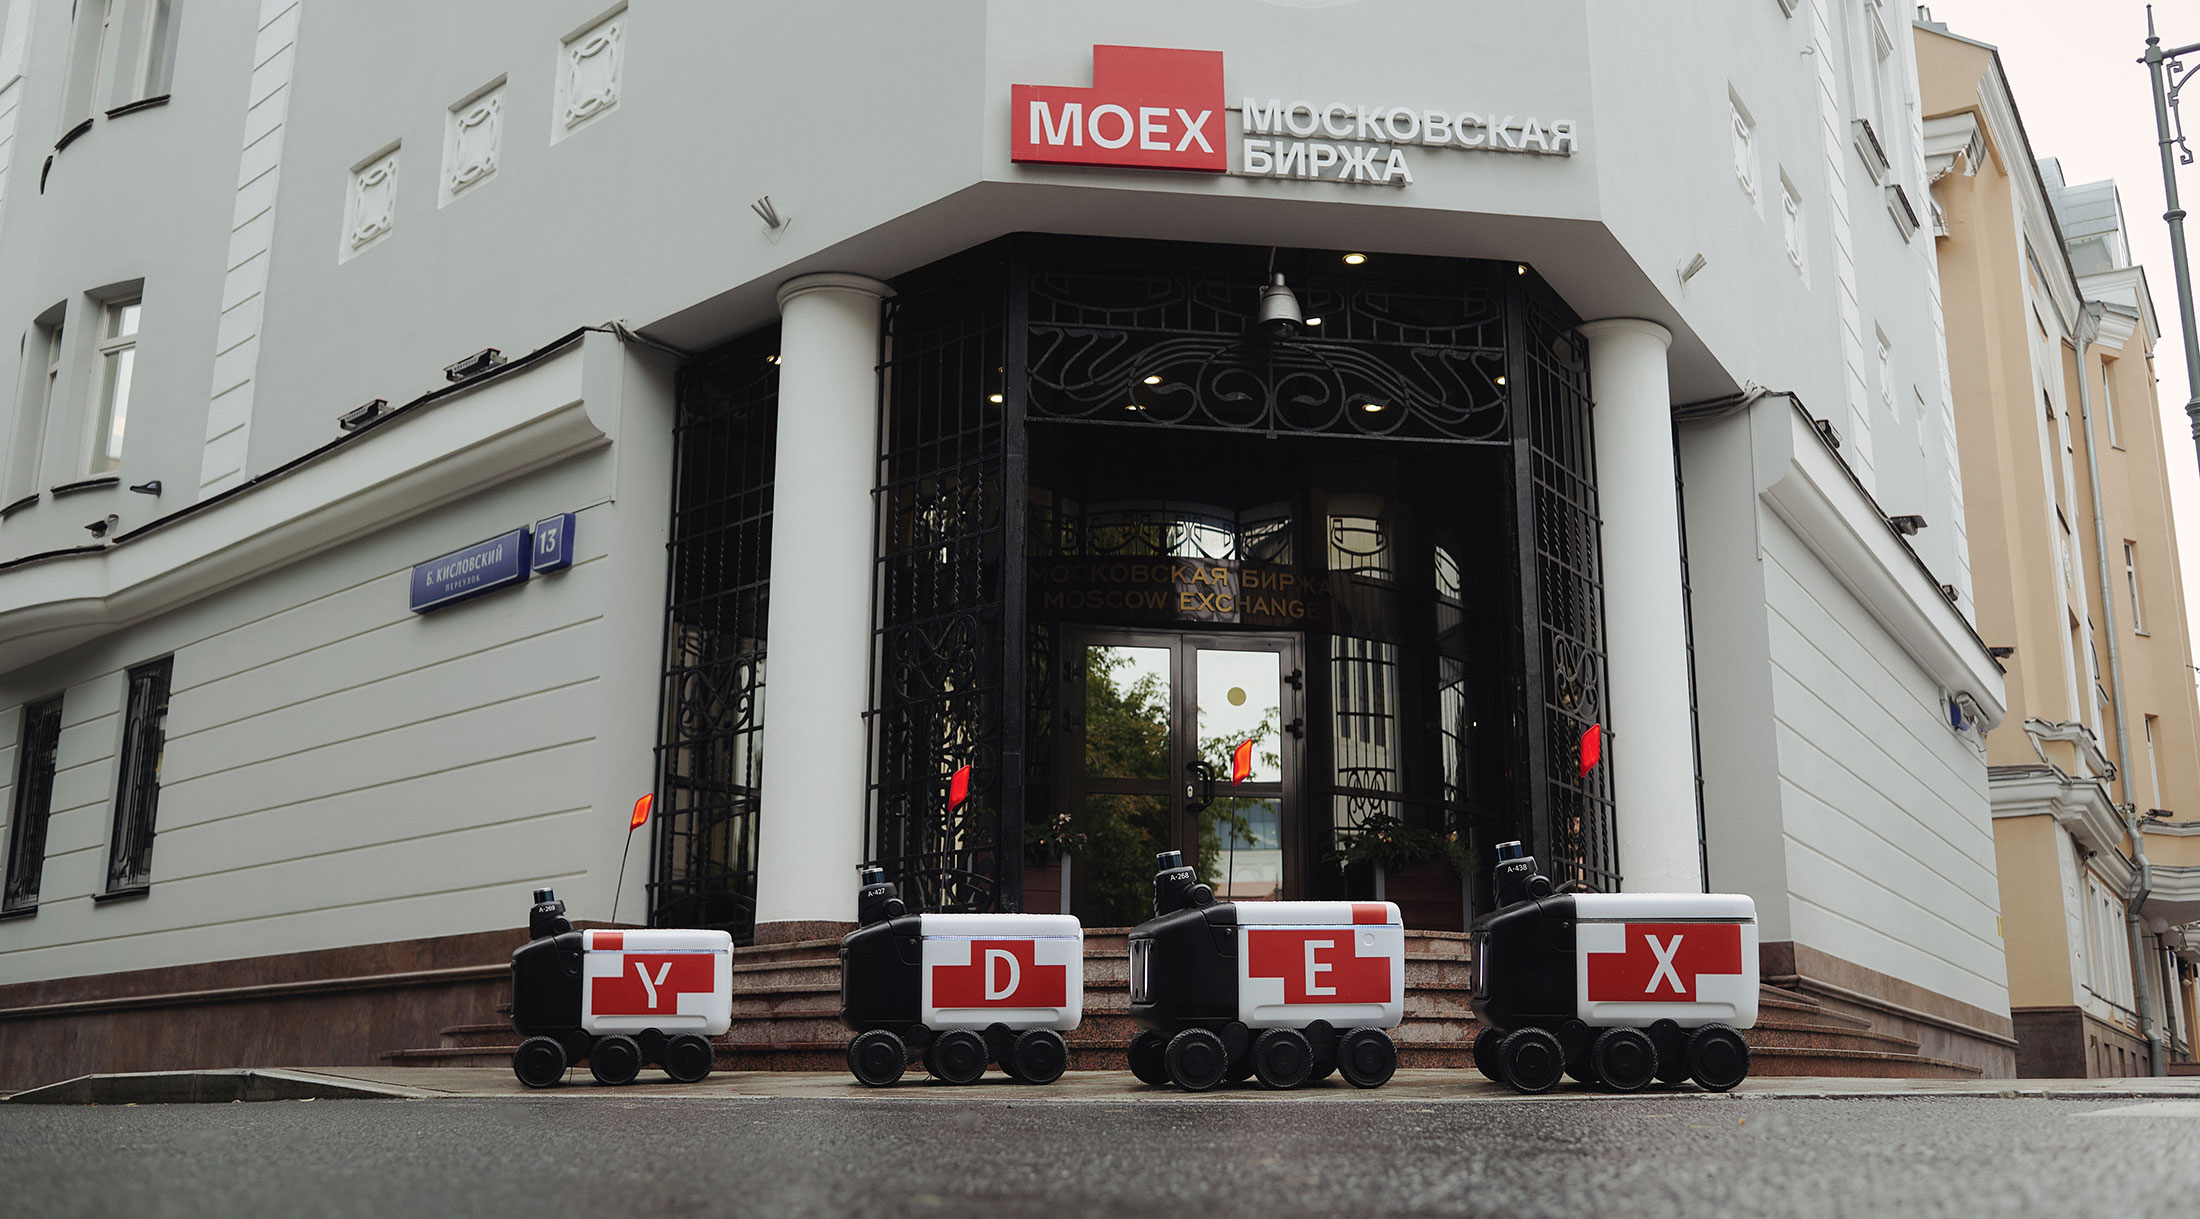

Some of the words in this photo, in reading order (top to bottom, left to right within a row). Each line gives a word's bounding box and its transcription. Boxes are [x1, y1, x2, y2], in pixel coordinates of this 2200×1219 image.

[1029, 101, 1215, 153] MOEX
[1242, 97, 1577, 154] МОСКОВСКАЯ
[1243, 139, 1413, 184] БИРЖА
[540, 528, 558, 554] 13
[426, 571, 435, 587] Б.
[436, 544, 503, 582] КИСЛОВСКИЙ
[445, 574, 481, 592] ПЕРЕУЛОК
[1043, 589, 1169, 610] MOSCOW
[1179, 592, 1322, 620] EXCHANGE
[634, 962, 672, 1008] Y
[985, 949, 1020, 1000] D
[1305, 940, 1337, 995] E
[1644, 934, 1687, 993] X
